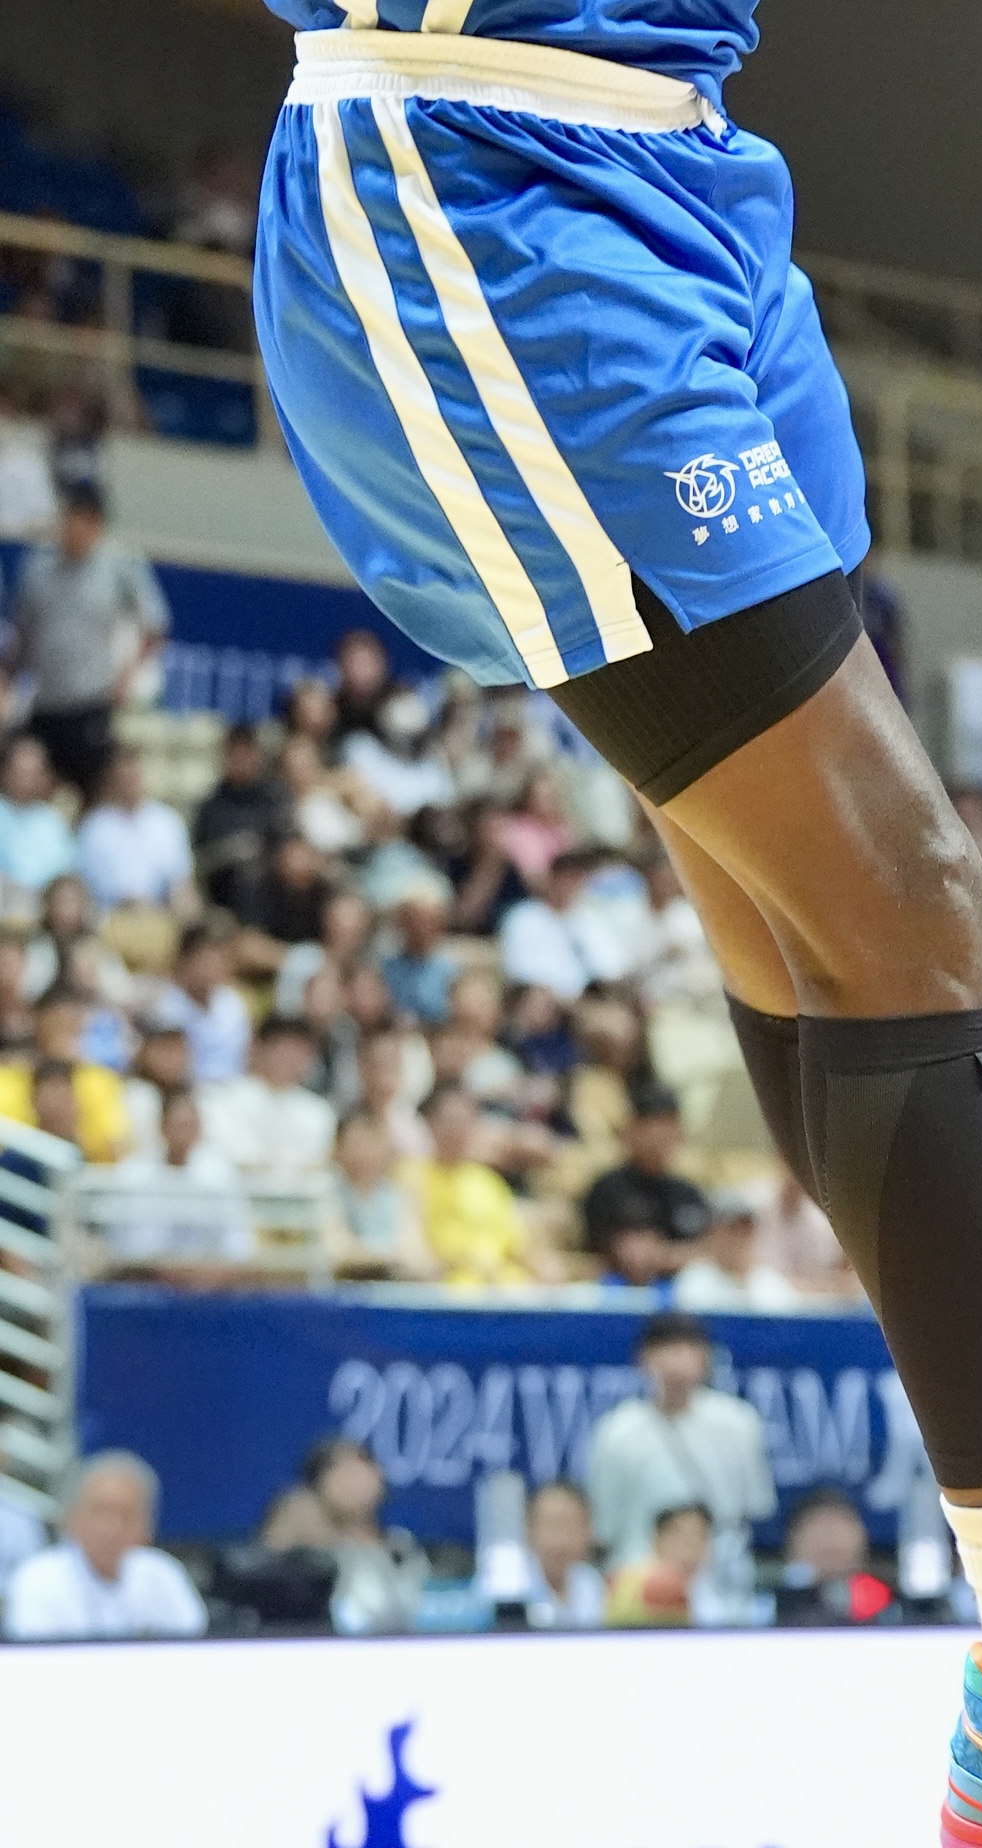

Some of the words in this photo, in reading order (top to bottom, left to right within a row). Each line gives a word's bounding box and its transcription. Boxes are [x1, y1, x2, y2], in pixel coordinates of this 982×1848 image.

[738, 440, 781, 471] DREA
[748, 458, 792, 489] ACAD
[328, 1358, 518, 1488] 2024
